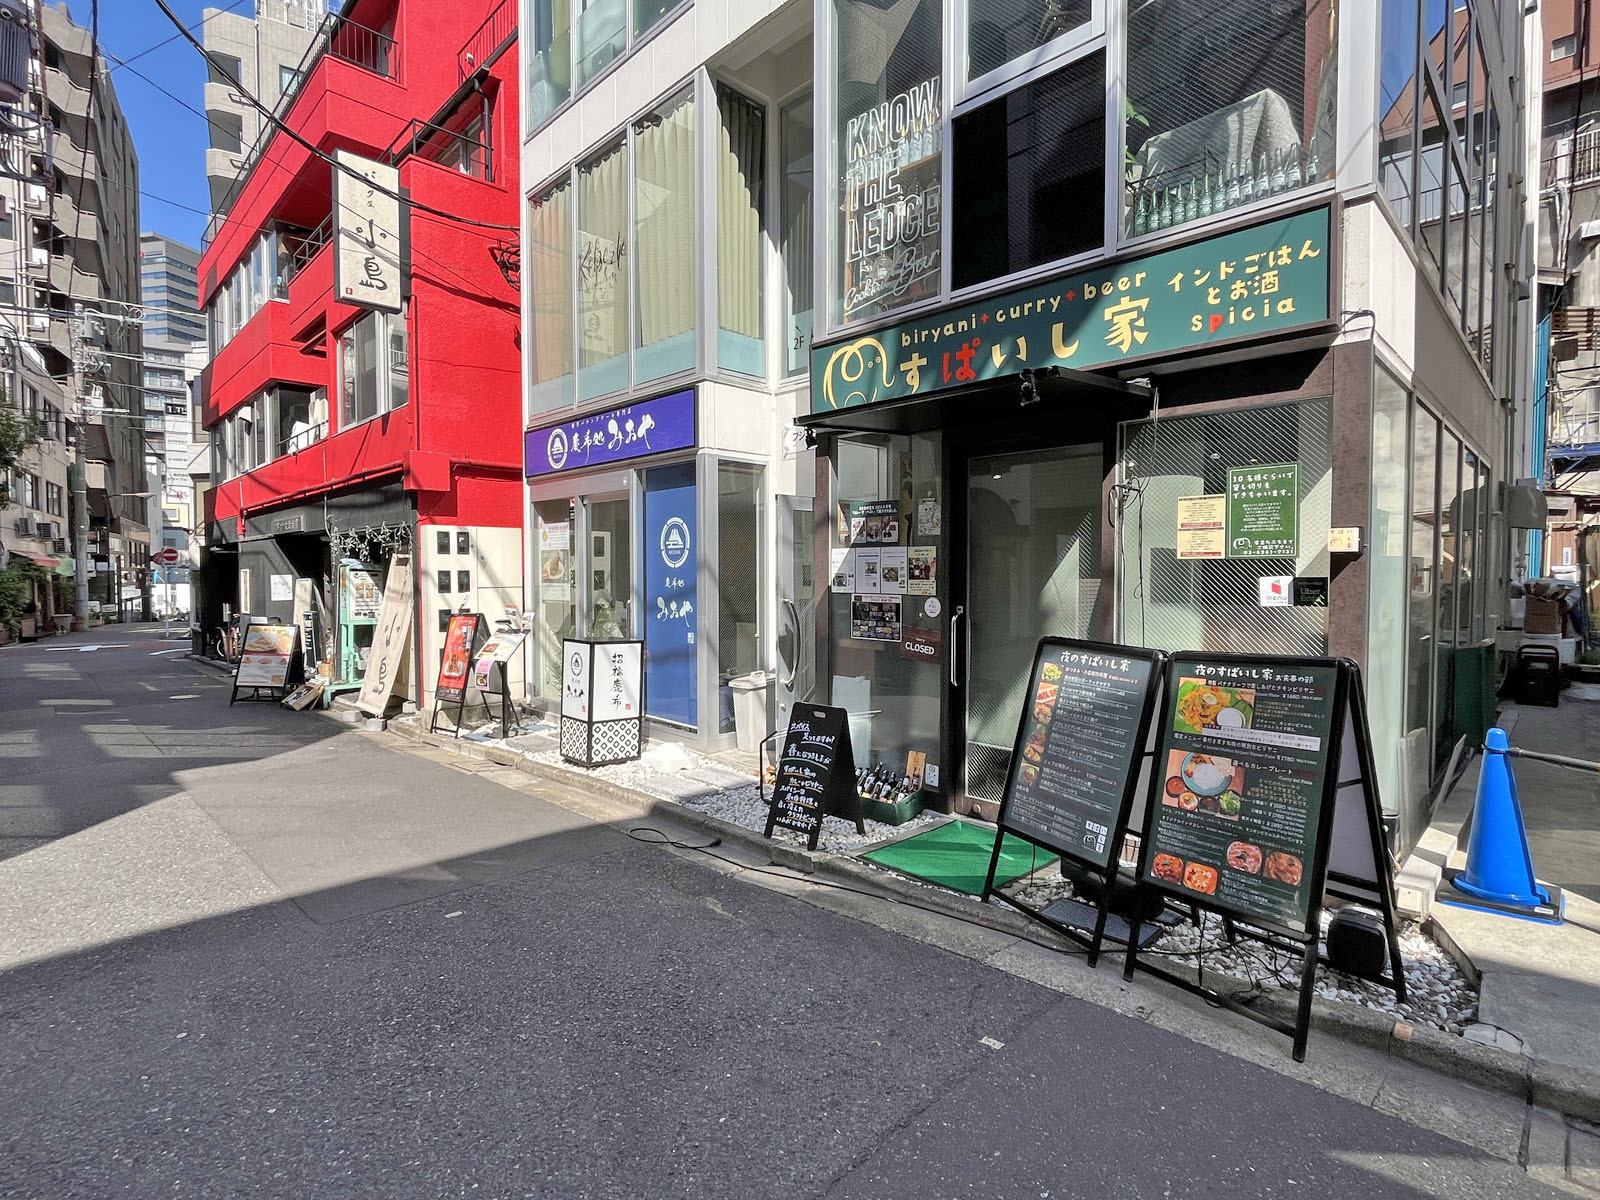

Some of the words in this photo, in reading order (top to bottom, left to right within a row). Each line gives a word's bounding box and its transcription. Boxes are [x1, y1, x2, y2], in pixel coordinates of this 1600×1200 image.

[847, 76, 941, 163] KNOW
[846, 150, 902, 212] THE
[846, 185, 941, 263] LEDGE
[893, 247, 940, 297] Bar
[1167, 240, 1322, 294] インドごはん
[1083, 271, 1148, 302] beer
[1206, 274, 1280, 306] とお酒
[1190, 298, 1297, 333] spicia
[793, 335, 805, 350] 2F
[899, 296, 1151, 395] すぱいし家
[607, 413, 656, 452] みおや
[656, 596, 694, 628] みおや
[905, 641, 935, 655] CLOSED
[790, 722, 811, 731] スパイス
